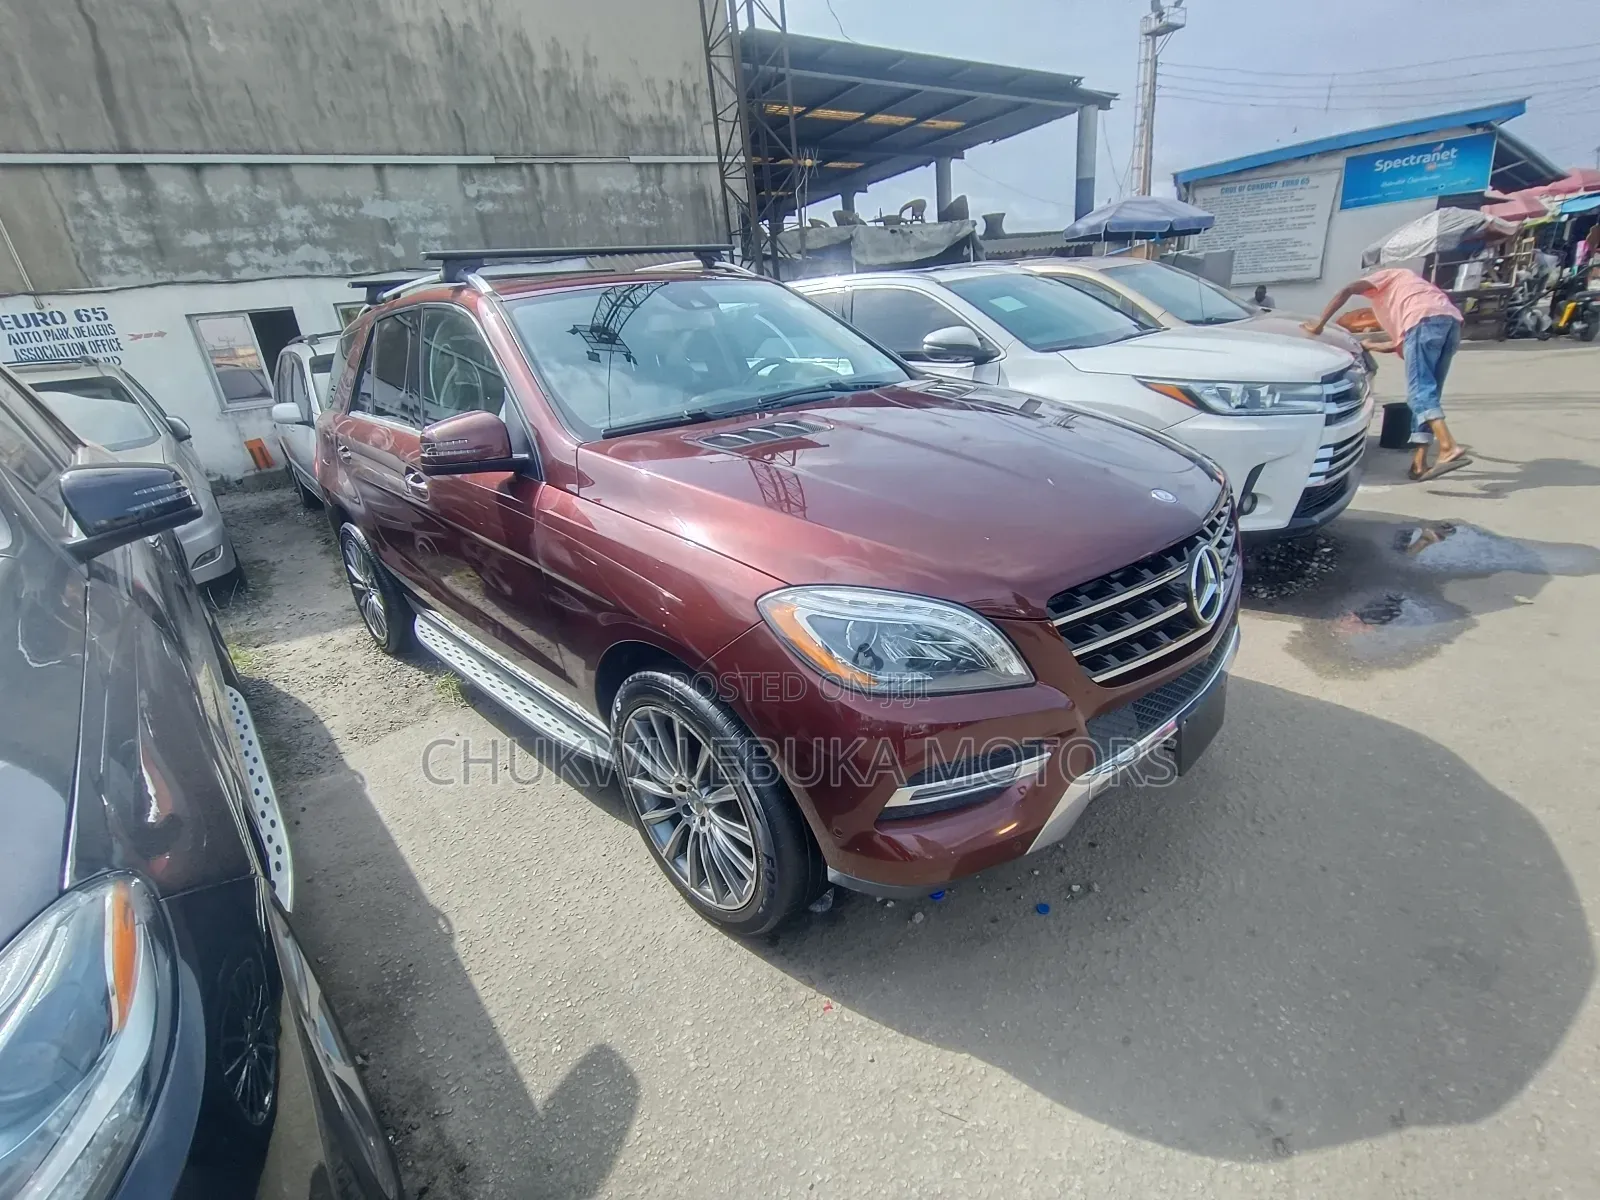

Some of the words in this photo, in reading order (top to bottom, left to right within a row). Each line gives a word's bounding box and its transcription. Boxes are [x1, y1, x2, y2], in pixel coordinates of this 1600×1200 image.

[1374, 147, 1459, 173] Spectranet
[1247, 181, 1277, 192] CONDUCT
[0, 310, 67, 330] EURO
[74, 306, 109, 322] 65
[8, 330, 43, 345] AUTO
[43, 326, 74, 341] PARK
[72, 323, 116, 341] DEALERS
[14, 341, 88, 362] ASSOCIATION
[88, 338, 124, 354] OFFICE
